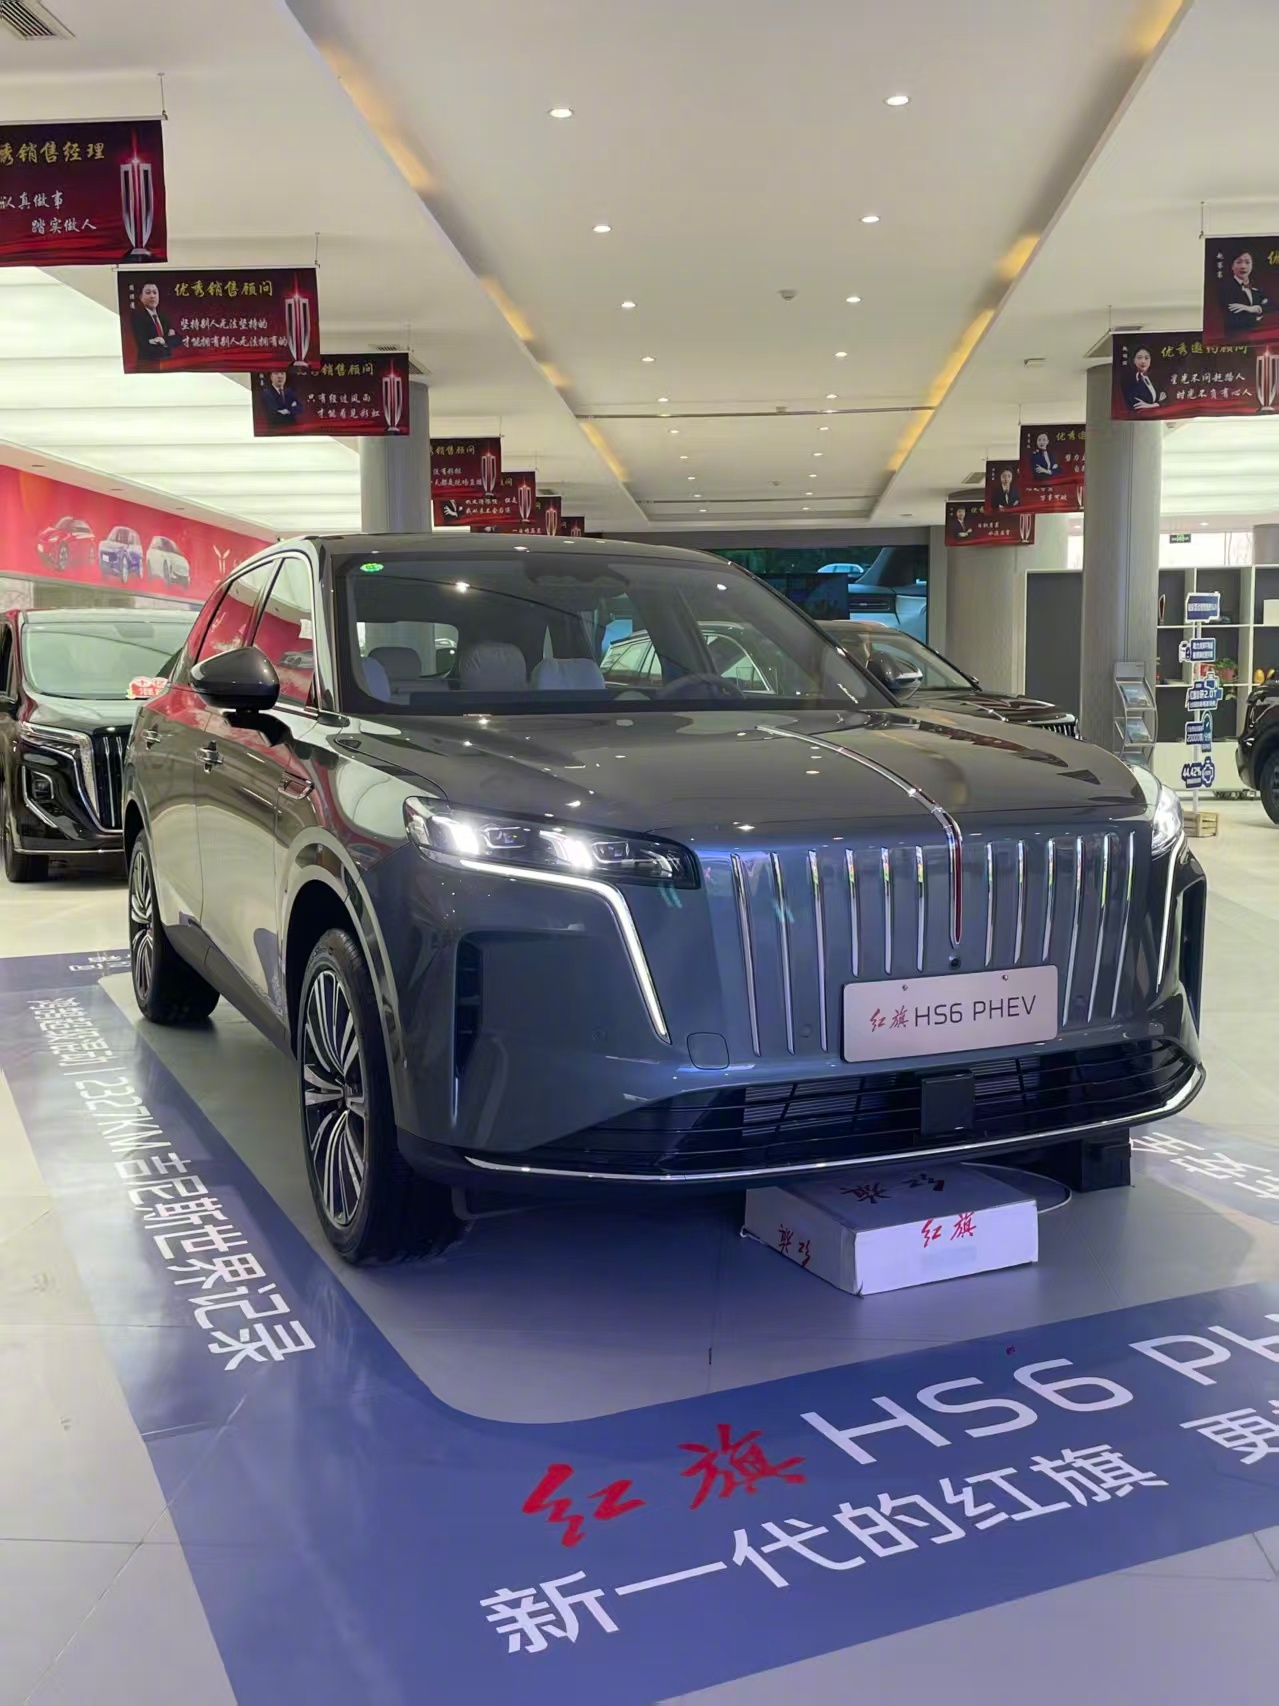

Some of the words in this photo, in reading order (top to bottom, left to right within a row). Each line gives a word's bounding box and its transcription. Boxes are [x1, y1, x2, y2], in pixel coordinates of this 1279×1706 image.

[32, 217, 97, 234] 踏实做人
[174, 280, 274, 298] 优秀销售顾问
[180, 317, 268, 331] 坚持别人无法坚持的
[181, 334, 289, 349] 才能拥有别人无法拥有的
[1170, 372, 1246, 385] 星光不问赶路人
[307, 393, 371, 404] 只有经过风雨
[1176, 387, 1252, 401] 时光不负有心人
[316, 407, 381, 419] 才能看见彩虹
[430, 445, 475, 456] 销售顾问
[869, 1005, 910, 1032] 红旗
[915, 1003, 963, 1027] HS6
[973, 995, 1037, 1021] PHEV
[921, 1211, 977, 1248] 红旗
[521, 1424, 806, 1547] 红旗
[800, 1358, 1134, 1465] HS6
[480, 1444, 1170, 1654] 新一代的红旗
